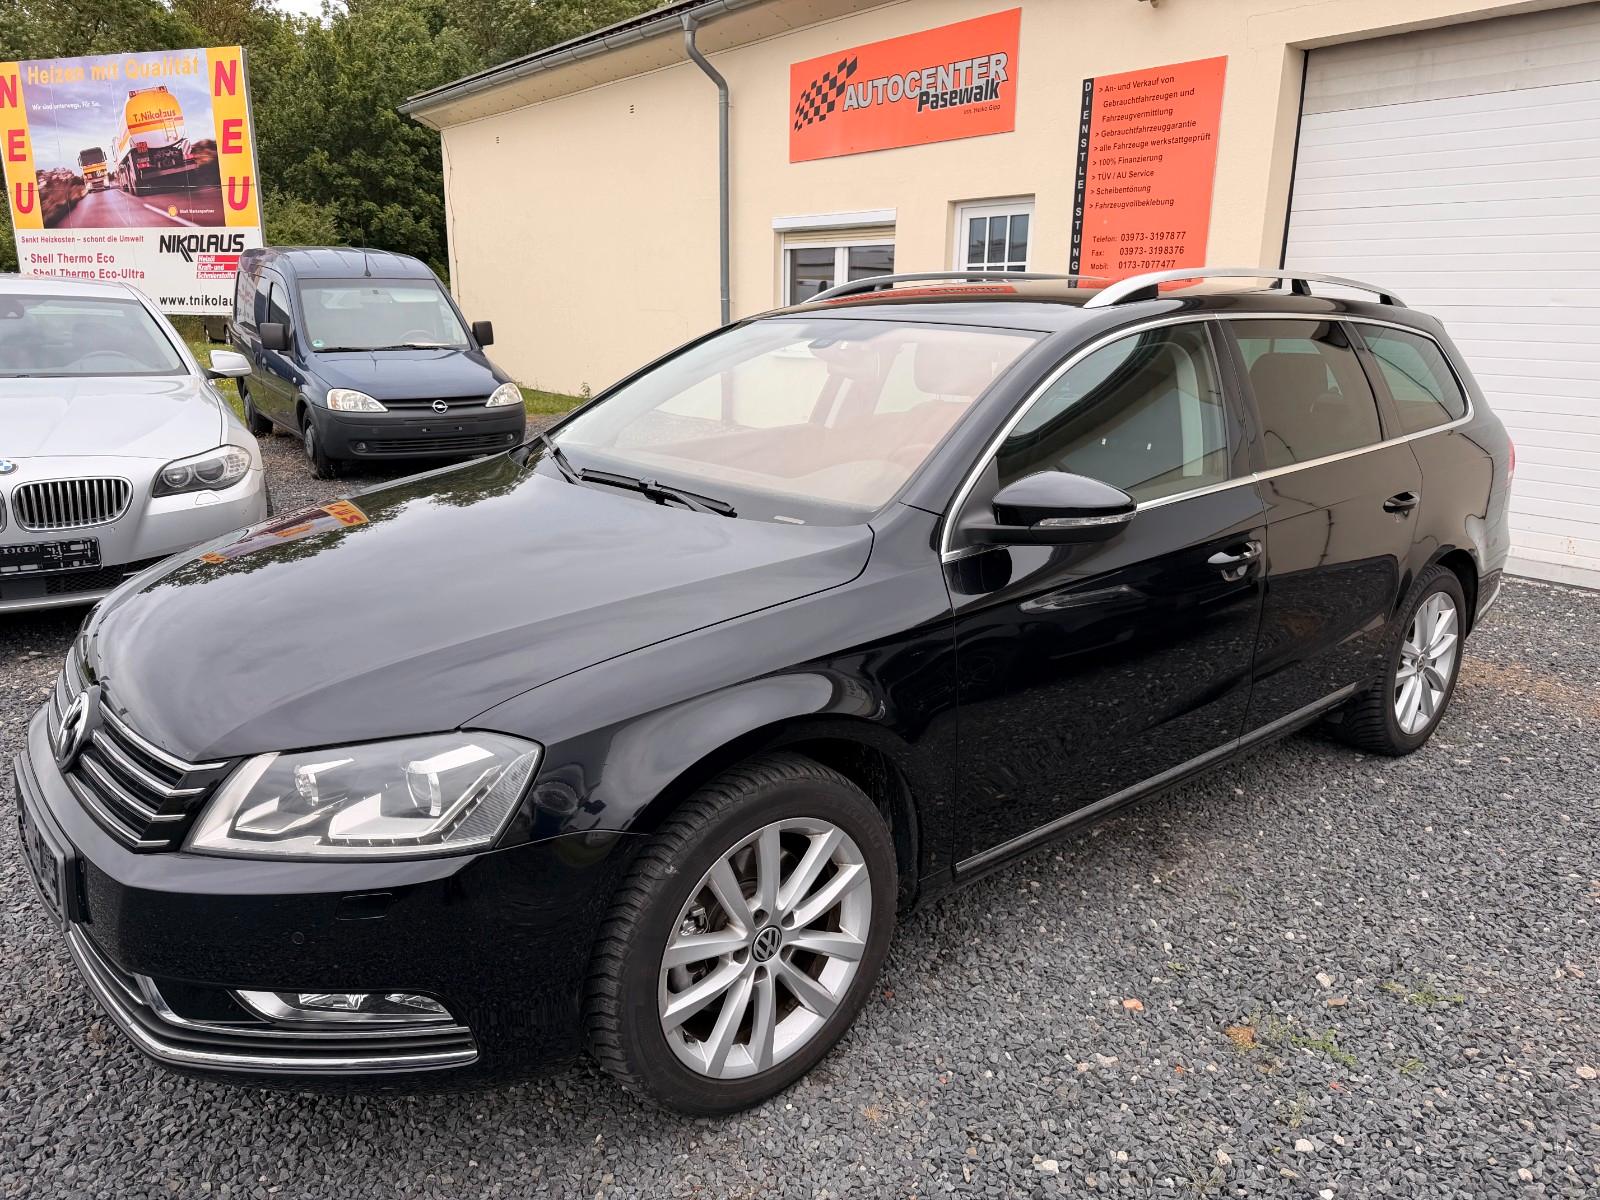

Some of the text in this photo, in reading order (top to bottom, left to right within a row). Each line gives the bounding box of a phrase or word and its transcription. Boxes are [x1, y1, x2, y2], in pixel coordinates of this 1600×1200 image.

[27, 56, 199, 85] Heizen mit Qualität
[842, 52, 1008, 112] AUTOCENTER
[1104, 76, 1175, 93] An- und Verkauf von
[917, 77, 999, 112] Pasewalk
[1103, 88, 1195, 108] Gebrauchtfahrzeugen und
[1102, 108, 1174, 123] Fahrzeugvermittlung
[214, 59, 250, 211] NEU
[1101, 120, 1197, 138] Gebrauchtfahrzeuggarantie
[0, 75, 35, 214] NEU
[1099, 132, 1211, 152] alle Fahrzeuge werkstattgeprüft
[1099, 154, 1163, 166] 100% Finanzierung
[1071, 82, 1092, 270] DIENSTLEISTUNG
[1116, 171, 1127, 179] AU
[1128, 169, 1155, 178] Service
[1096, 185, 1152, 195] Scheibentönung
[1094, 199, 1175, 210] Fahrzeugvollbeklebung
[83, 235, 106, 243] schont
[119, 235, 144, 243] Umwelt
[159, 234, 245, 262] NIKOLAUS
[1091, 249, 1105, 257] Fax:
[30, 253, 115, 264] Shell Thermo Eco
[1090, 259, 1176, 270] Mobil: 0173-7077477
[33, 268, 145, 279] Shell Thermo Eco-Ultra
